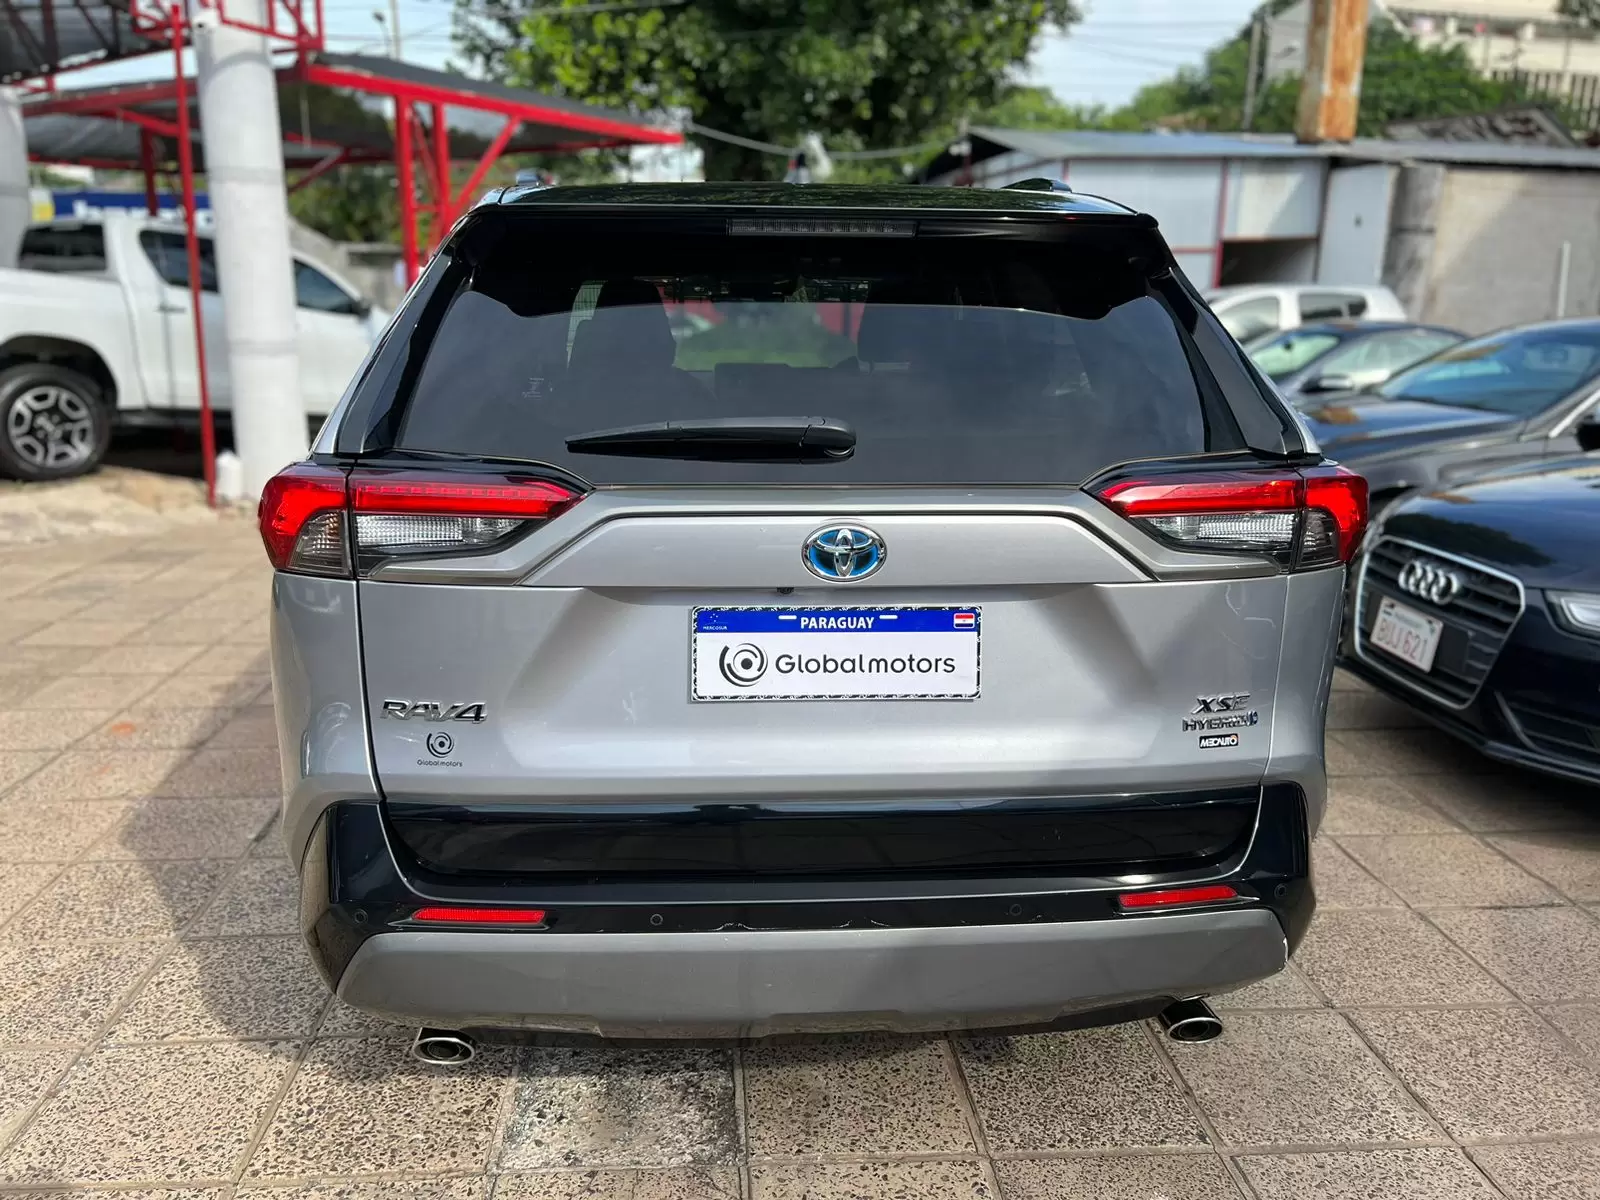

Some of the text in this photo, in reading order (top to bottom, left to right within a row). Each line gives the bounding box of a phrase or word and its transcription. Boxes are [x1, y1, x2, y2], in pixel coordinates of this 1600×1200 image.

[801, 616, 875, 629] PARAGUAY
[775, 653, 956, 674] Globalmotors
[380, 699, 488, 724] RAV4
[1191, 692, 1251, 715] XSE
